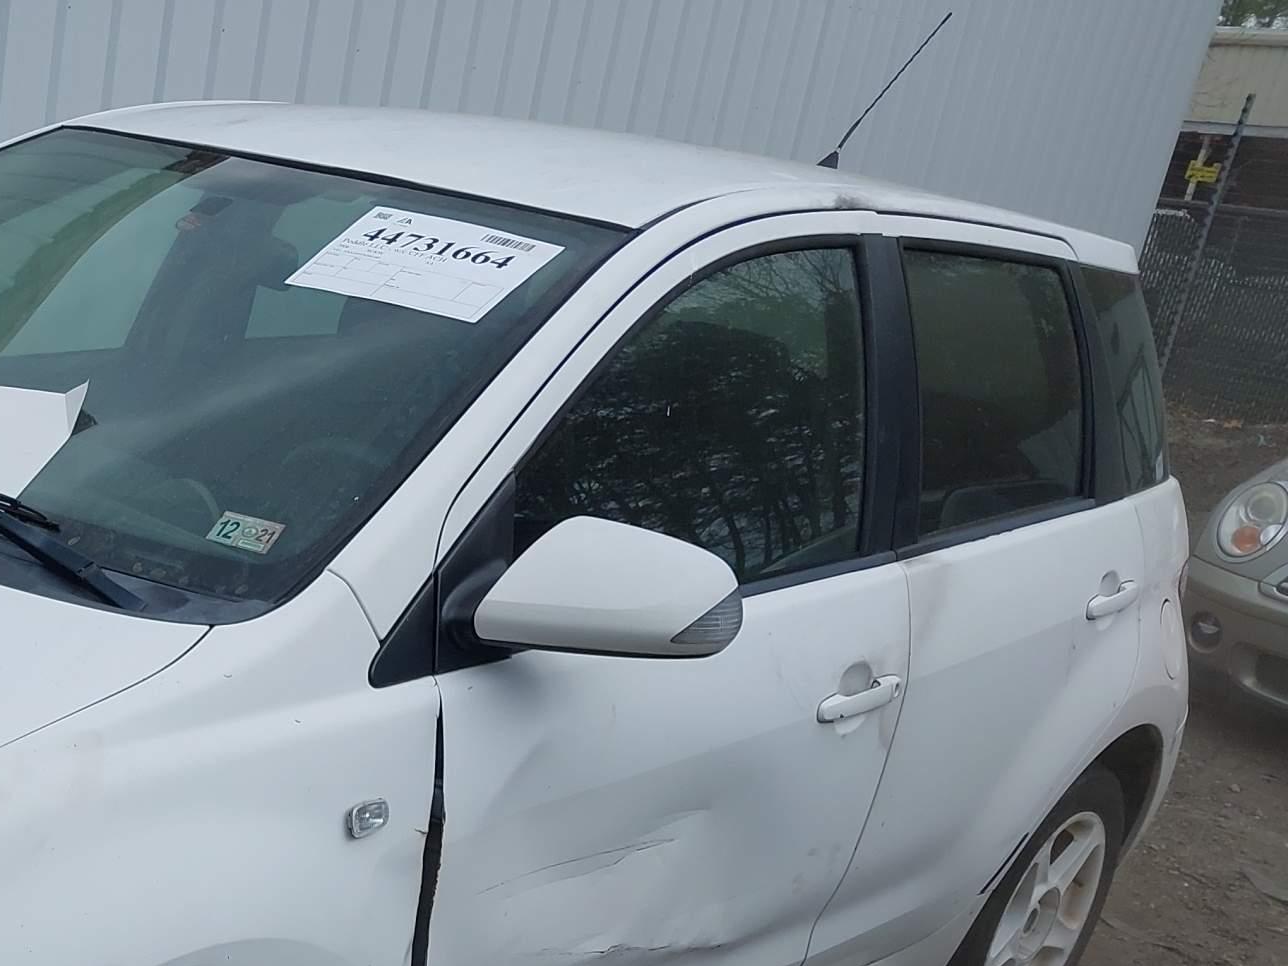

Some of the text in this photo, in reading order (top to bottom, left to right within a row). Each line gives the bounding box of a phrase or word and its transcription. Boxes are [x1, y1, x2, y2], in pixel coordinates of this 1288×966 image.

[362, 227, 516, 270] 44731664
[216, 519, 240, 539] 12
[256, 528, 276, 544] 21
